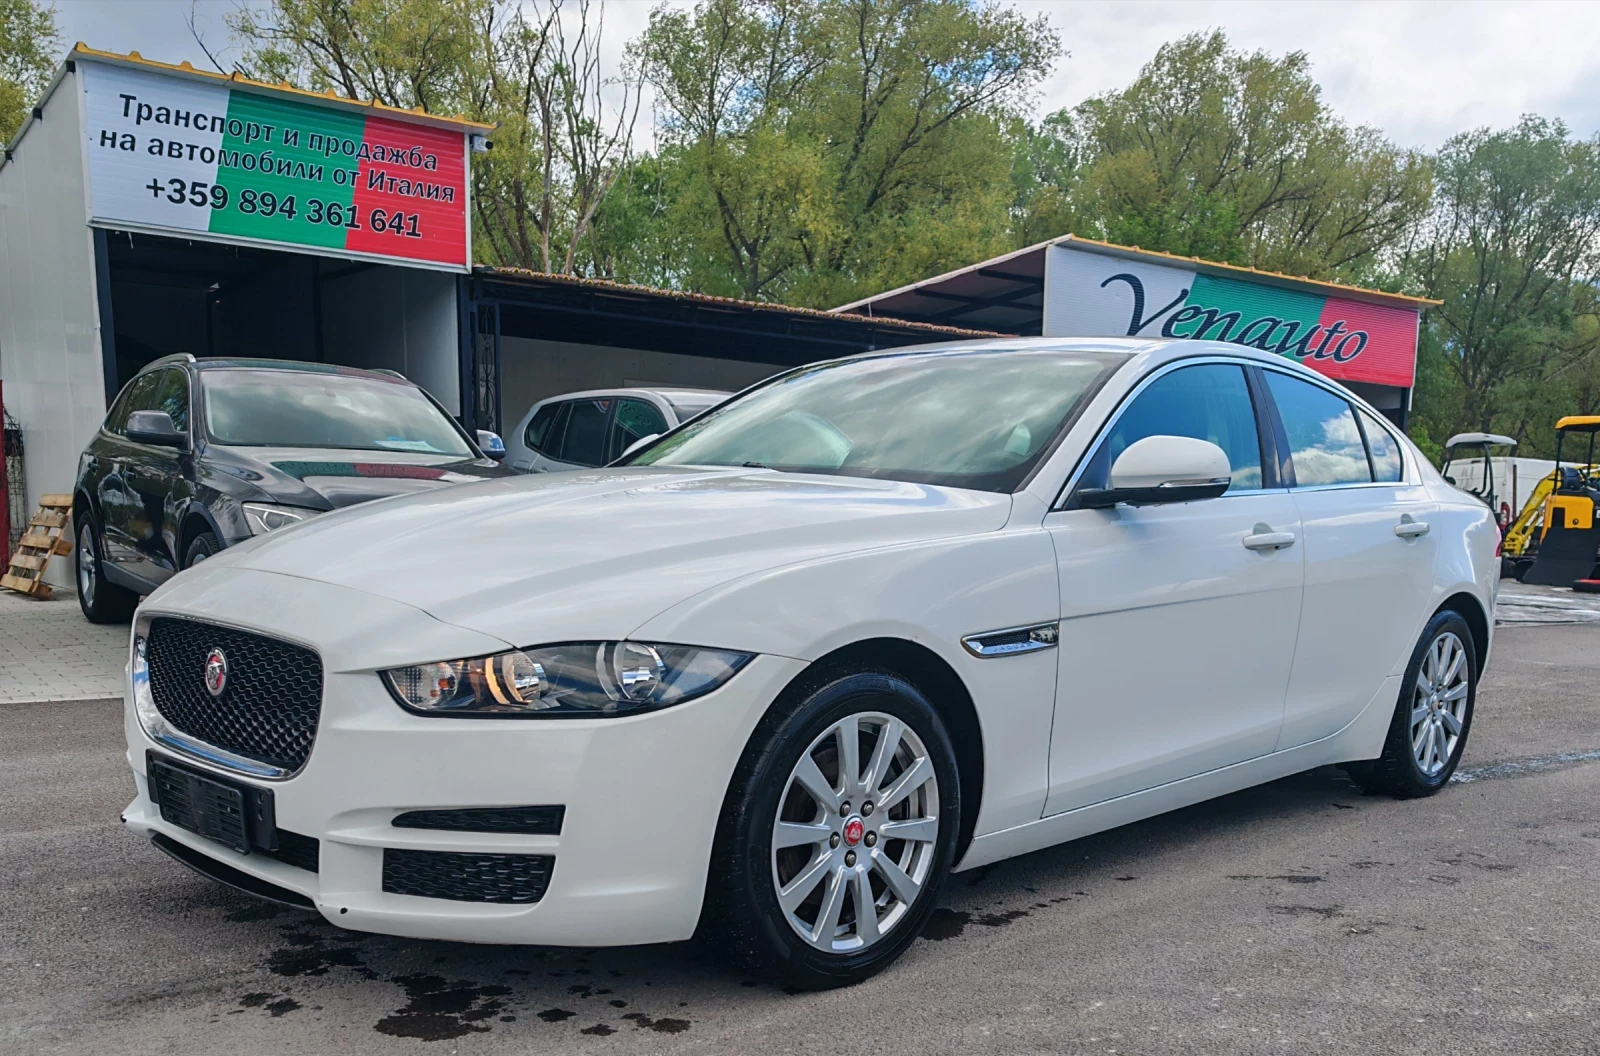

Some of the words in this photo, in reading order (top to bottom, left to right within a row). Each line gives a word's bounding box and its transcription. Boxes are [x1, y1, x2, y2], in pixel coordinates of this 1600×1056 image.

[99, 129, 136, 153] на
[147, 136, 323, 182] автомобили
[332, 169, 361, 188] от
[367, 169, 456, 203] Италия
[118, 93, 276, 144] Транспорт
[283, 129, 299, 149] и
[308, 133, 438, 171] продажба
[145, 177, 229, 211] +359
[238, 189, 298, 220] 894
[305, 199, 362, 230] 361
[369, 208, 423, 239] 641
[1100, 273, 1369, 363] Venauto
[993, 643, 1032, 652] JAGUAR
